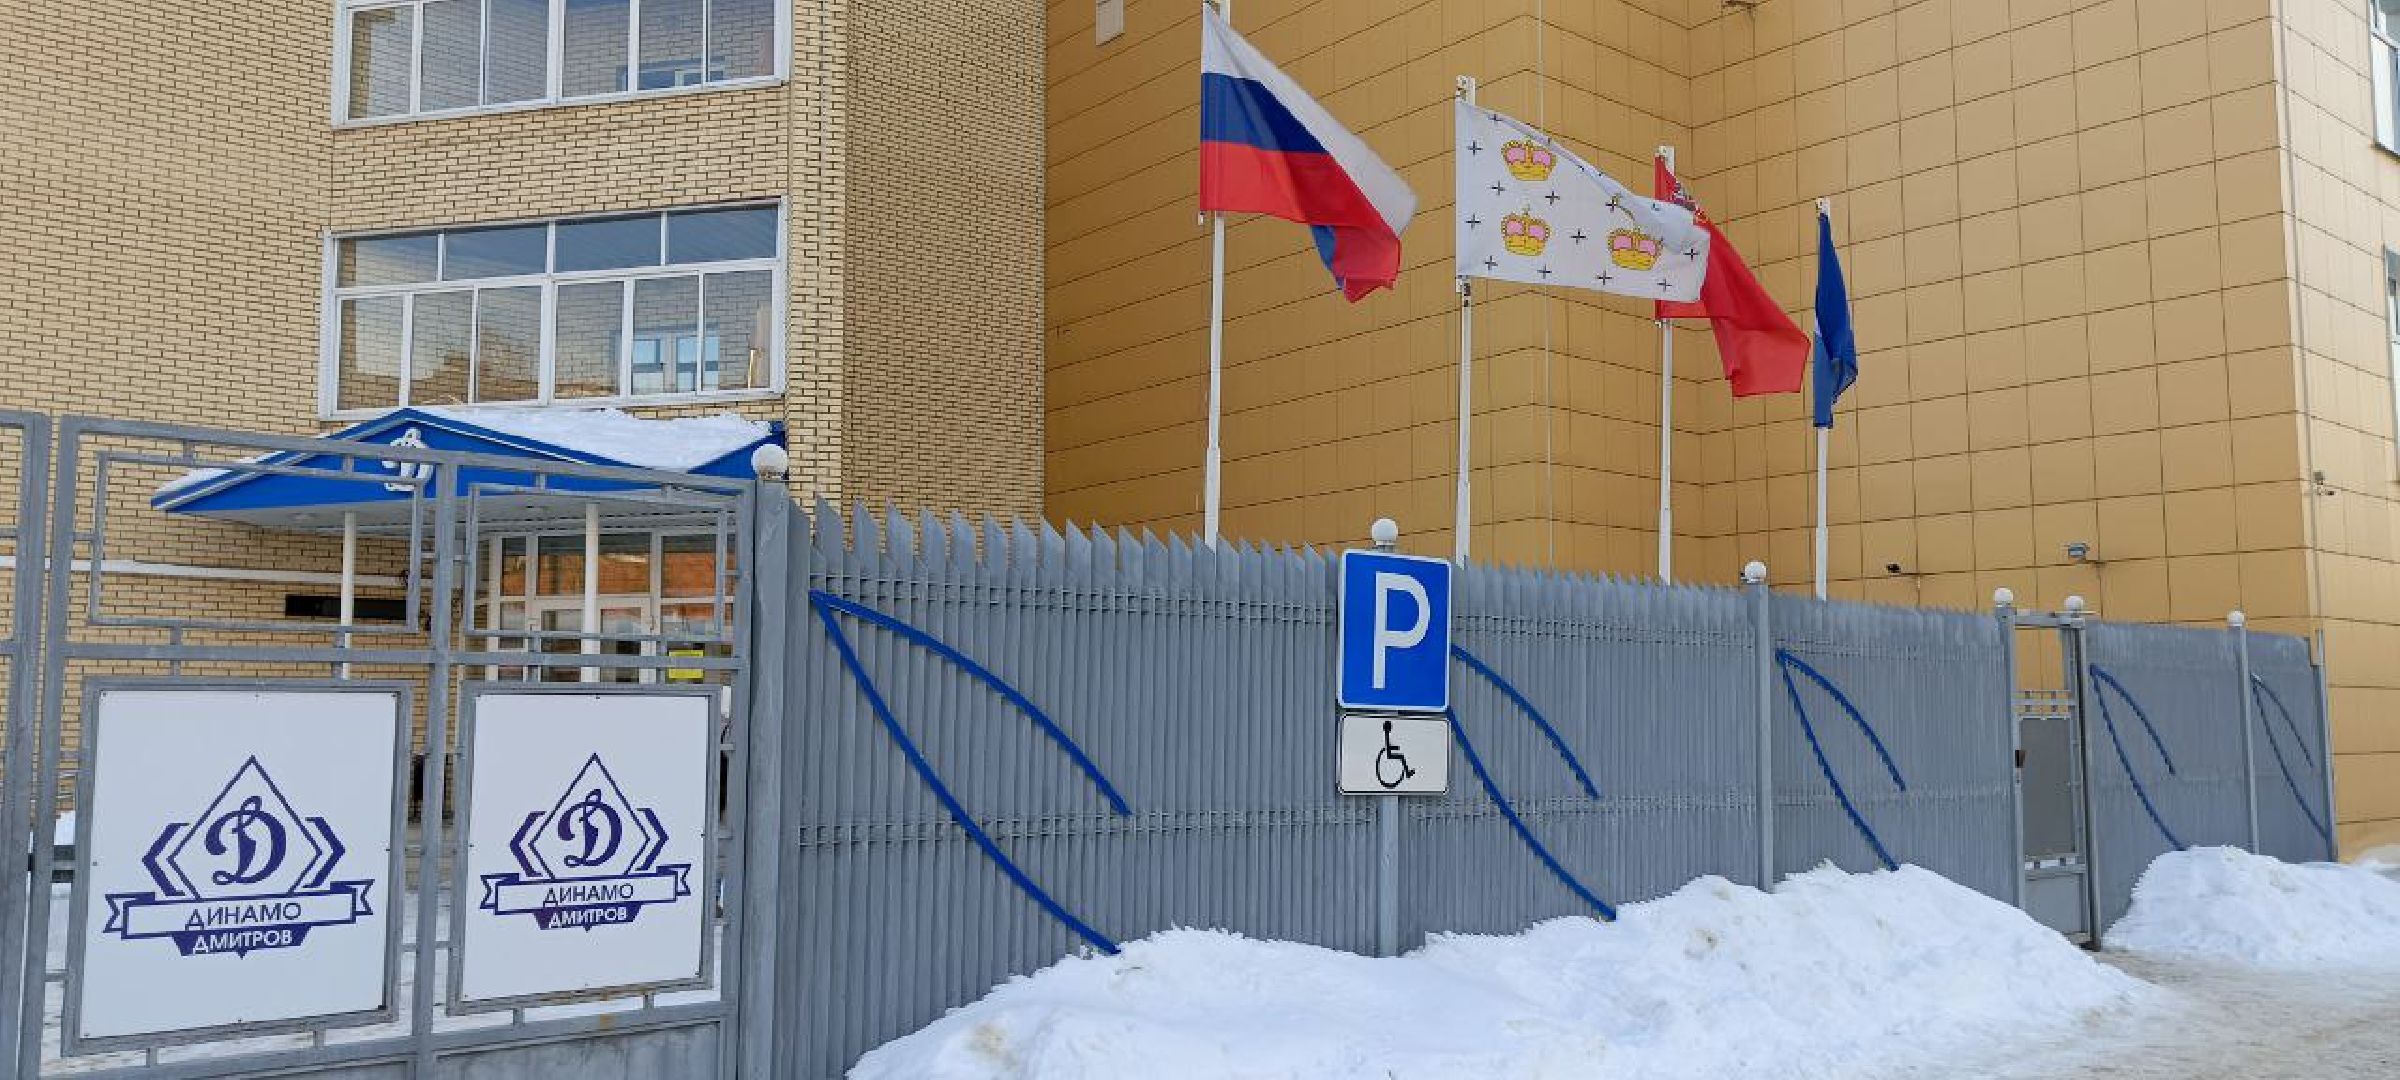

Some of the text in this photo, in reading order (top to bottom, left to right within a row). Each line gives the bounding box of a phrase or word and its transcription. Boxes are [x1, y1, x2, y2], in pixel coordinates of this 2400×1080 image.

[1372, 571, 1430, 689] P
[542, 882, 634, 908] ДИНАМО
[184, 902, 302, 932] ДИНАМО
[548, 907, 627, 929] ДМИТРОВ
[193, 929, 293, 955] ДМИТРОВ
